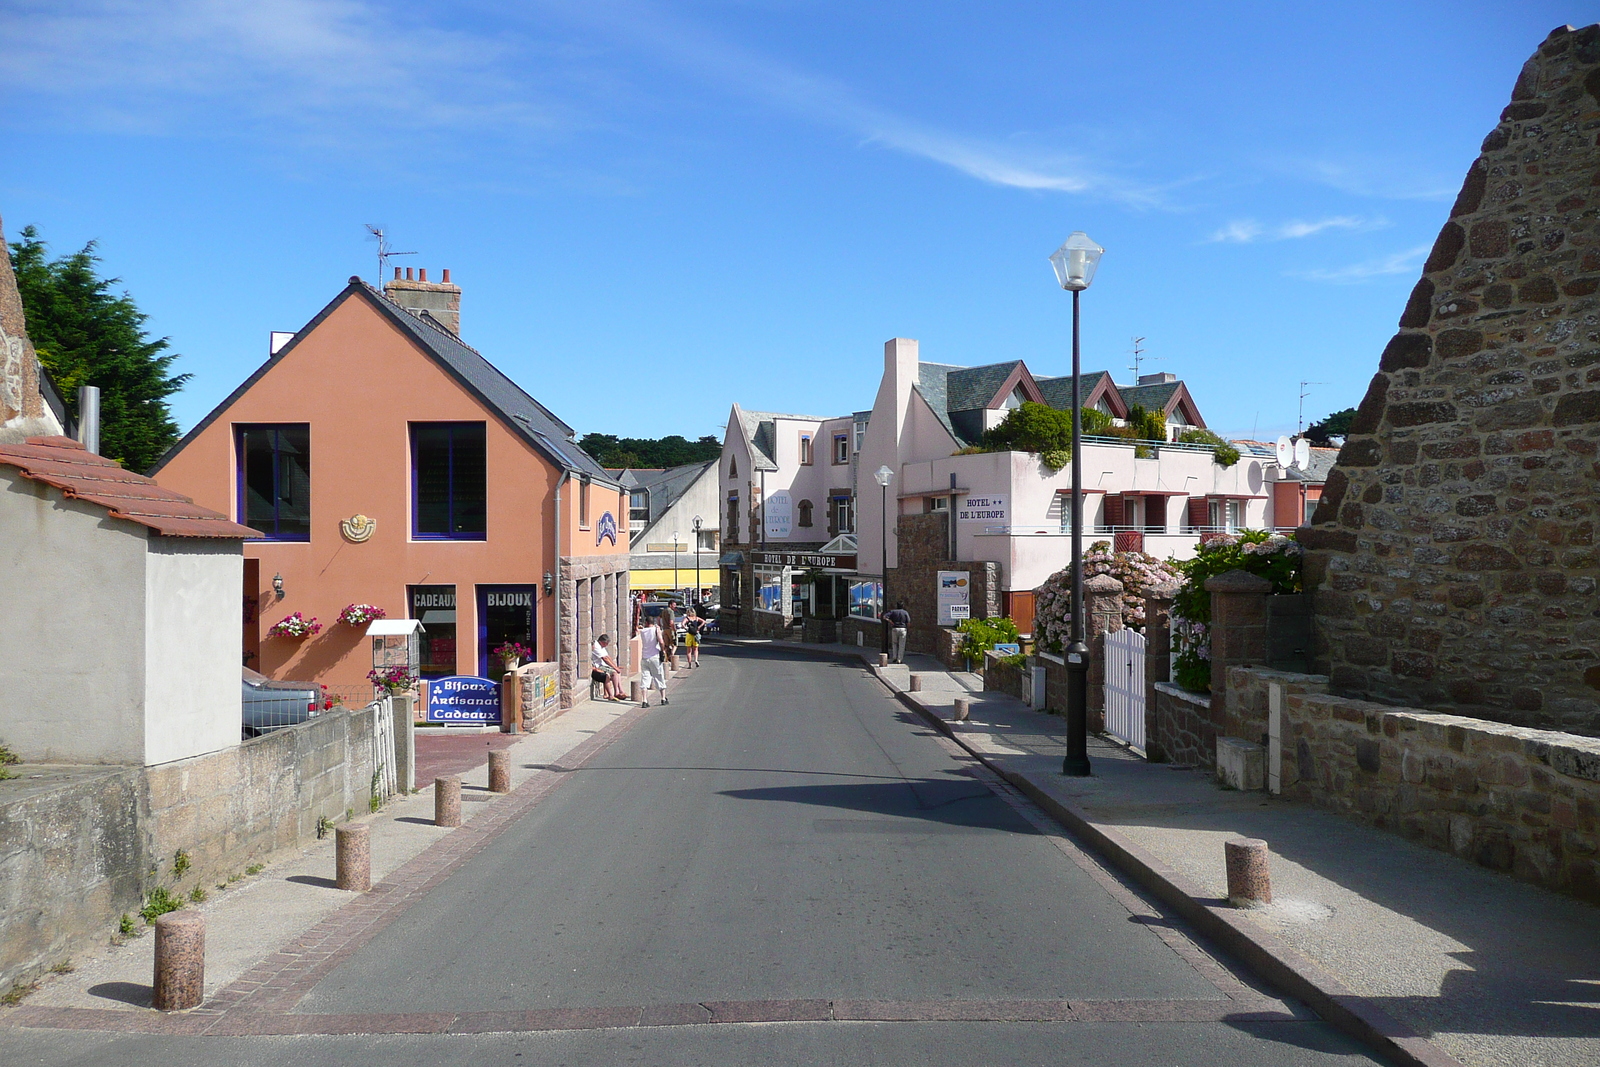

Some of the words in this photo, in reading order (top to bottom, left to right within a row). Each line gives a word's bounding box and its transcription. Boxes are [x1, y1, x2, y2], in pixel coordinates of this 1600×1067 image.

[966, 498, 990, 507] HOTEL
[960, 511, 969, 519] DE
[971, 510, 1005, 519] L'EUROPE
[786, 555, 796, 565] DE
[414, 593, 456, 607] CADEAUX
[487, 593, 532, 607] BIJOUX
[444, 681, 487, 692] Bijoux
[430, 695, 499, 706] Artisanat
[434, 709, 496, 719] Cadeaux
